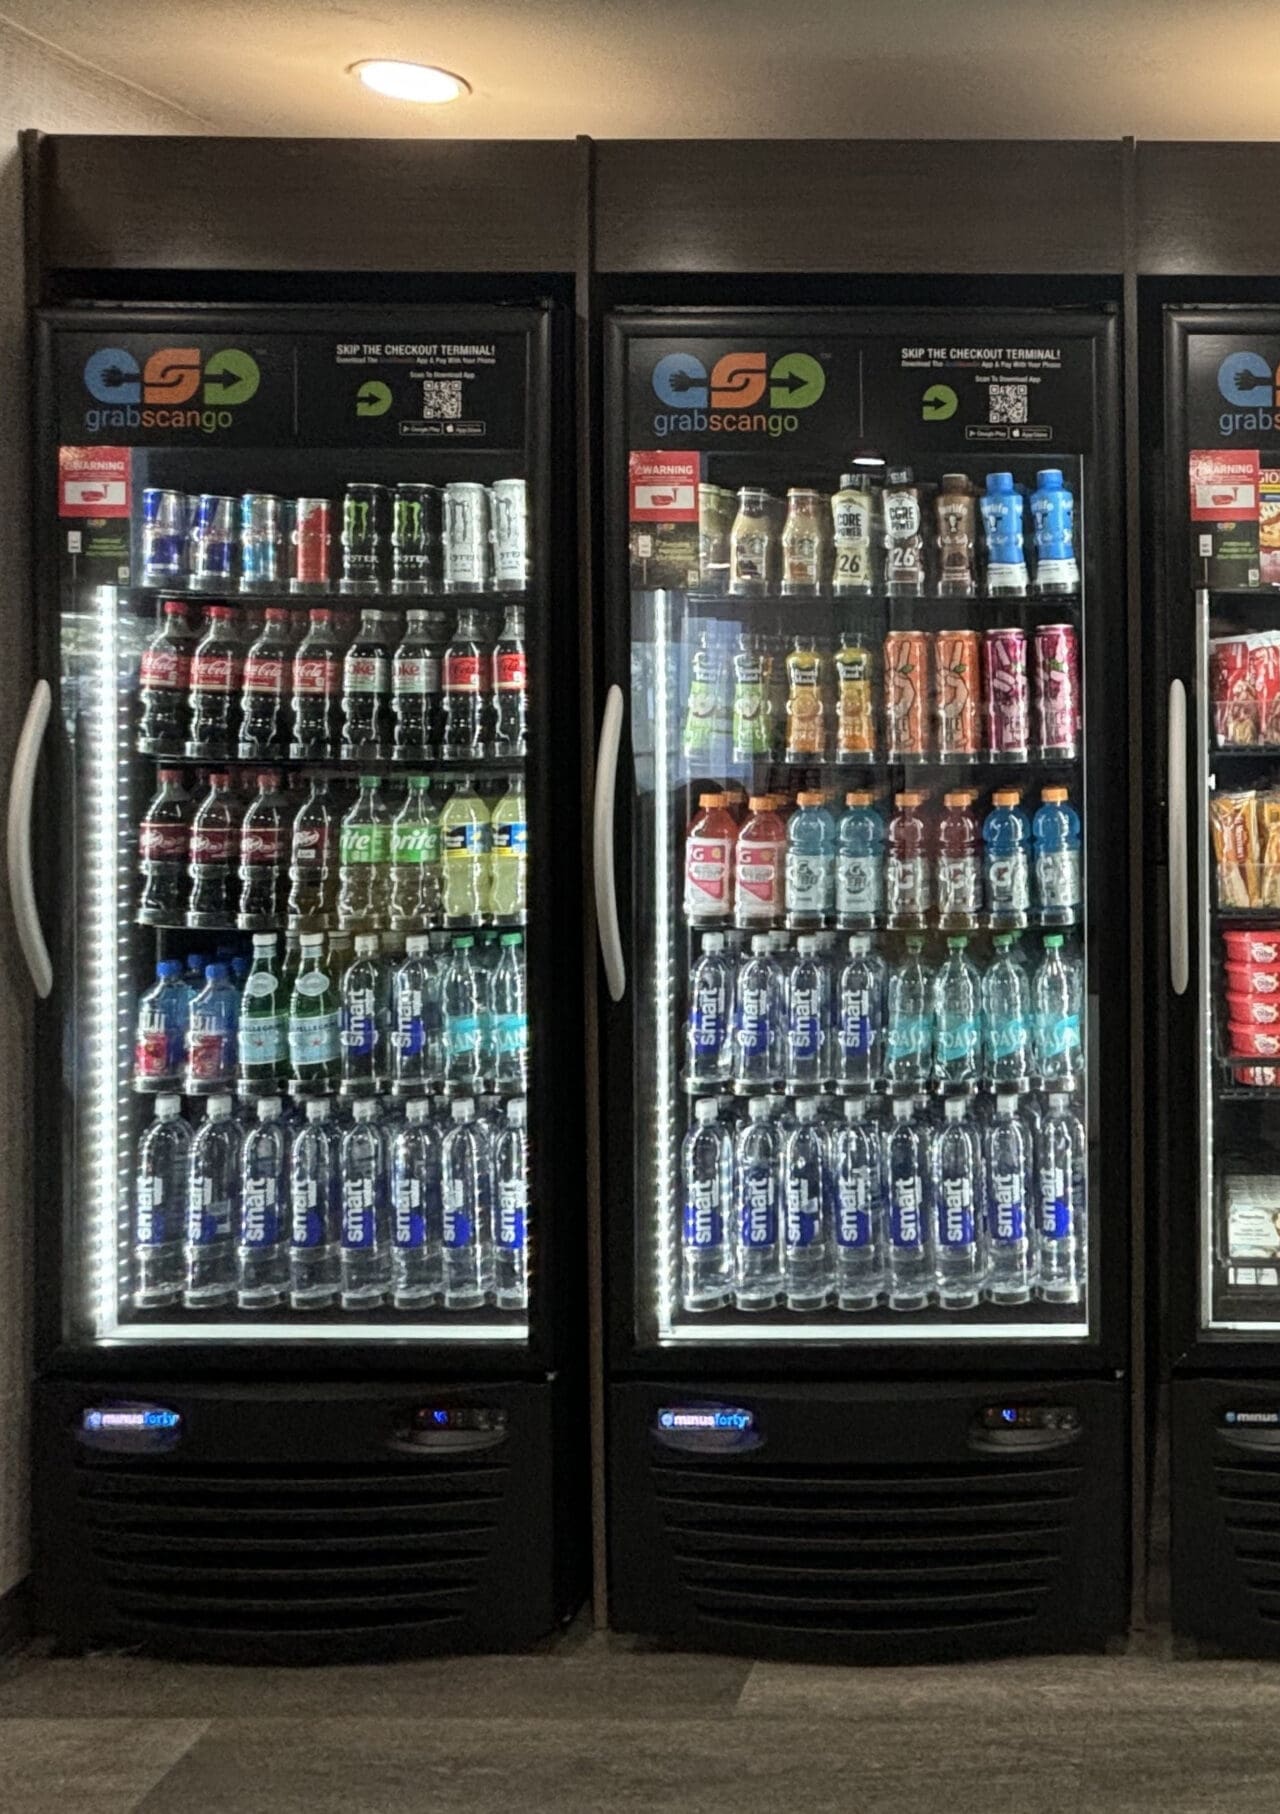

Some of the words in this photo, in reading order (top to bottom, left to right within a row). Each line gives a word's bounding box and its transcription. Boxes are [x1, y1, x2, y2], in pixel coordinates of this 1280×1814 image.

[336, 344, 360, 356] SKIP
[362, 344, 382, 356] THE
[384, 344, 437, 356] CHECKOUT
[440, 344, 496, 356] TERMINAL!
[901, 347, 925, 360] SKIP
[928, 347, 947, 360] THE
[949, 347, 1003, 360] CHECKOUT
[1006, 348, 1061, 360] TERMINAL!
[85, 405, 232, 432] grabscango
[653, 411, 798, 437] grabscango
[643, 465, 693, 475] WARNING
[838, 513, 862, 526] CORE
[840, 555, 860, 573] 26
[894, 549, 914, 566] 26
[692, 850, 704, 860] G
[741, 853, 752, 863] G
[349, 988, 365, 1046] smart
[399, 990, 412, 1048] smart
[701, 988, 720, 1047] smart
[741, 989, 759, 1047] smart
[795, 987, 811, 1047] smart
[846, 988, 862, 1048] smart
[246, 1177, 264, 1241] smart
[346, 1178, 364, 1242] smart
[397, 1179, 411, 1242] smart
[695, 1178, 712, 1243] smart
[751, 1177, 767, 1242] smart
[842, 1175, 858, 1242] smart
[901, 1176, 918, 1241] smart
[948, 1178, 963, 1242] smart
[999, 1174, 1015, 1237] smart
[1042, 1168, 1057, 1232] smart
[674, 1412, 749, 1428] minusforty
